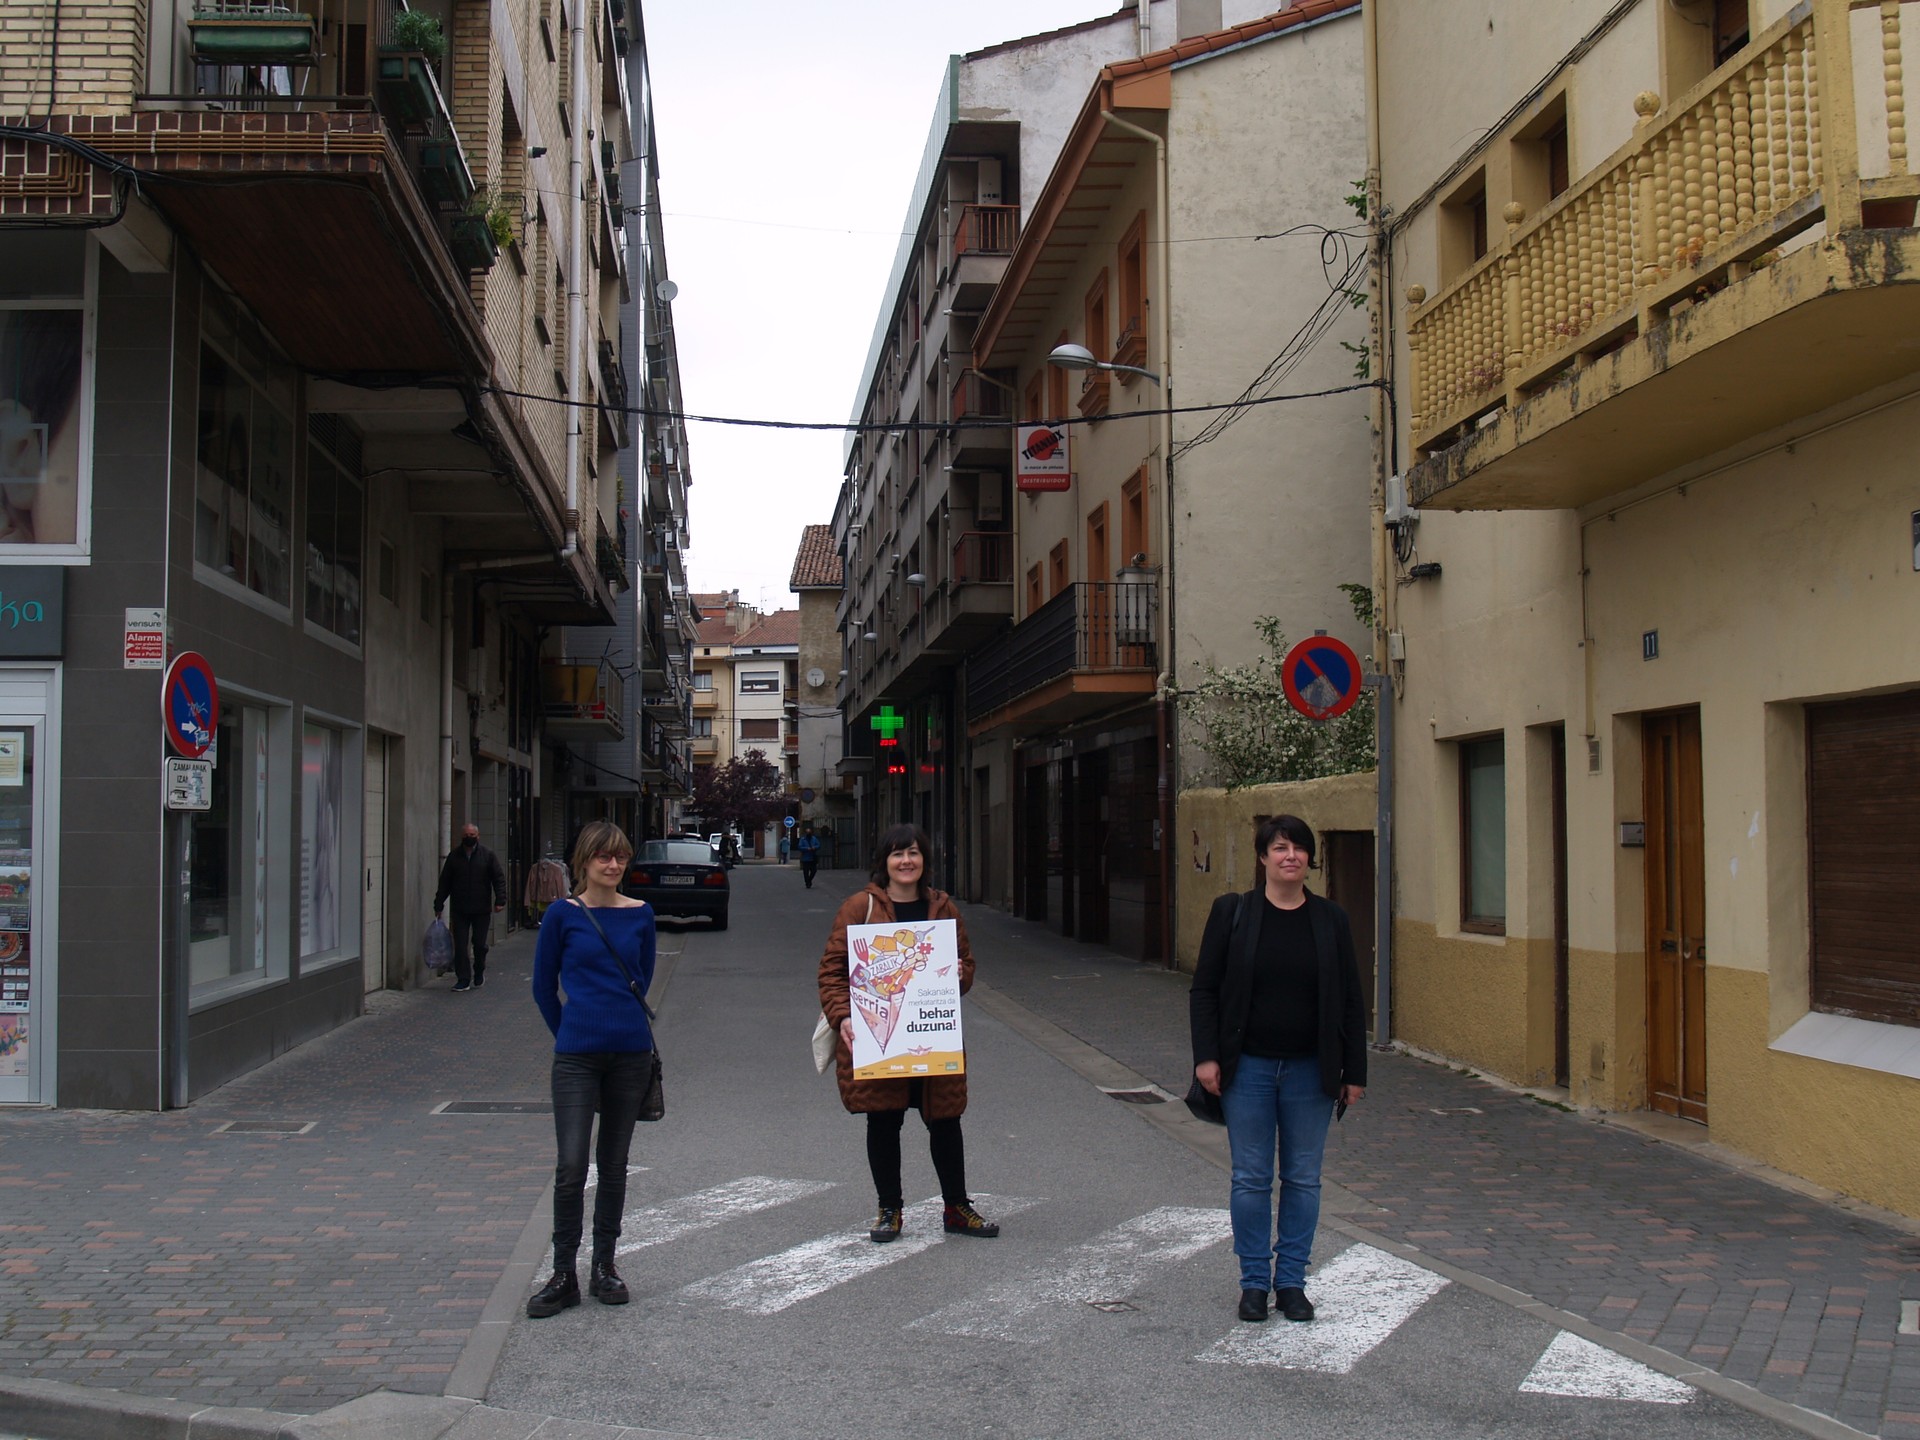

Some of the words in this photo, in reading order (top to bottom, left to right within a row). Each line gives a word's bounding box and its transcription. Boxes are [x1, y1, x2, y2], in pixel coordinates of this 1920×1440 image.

[1645, 634, 1655, 656] 11
[869, 957, 901, 976] ZABALIK
[917, 987, 956, 997] Sakanako
[851, 987, 889, 1020] berria
[919, 1007, 956, 1020] behar
[906, 1020, 957, 1033] duzuna!
